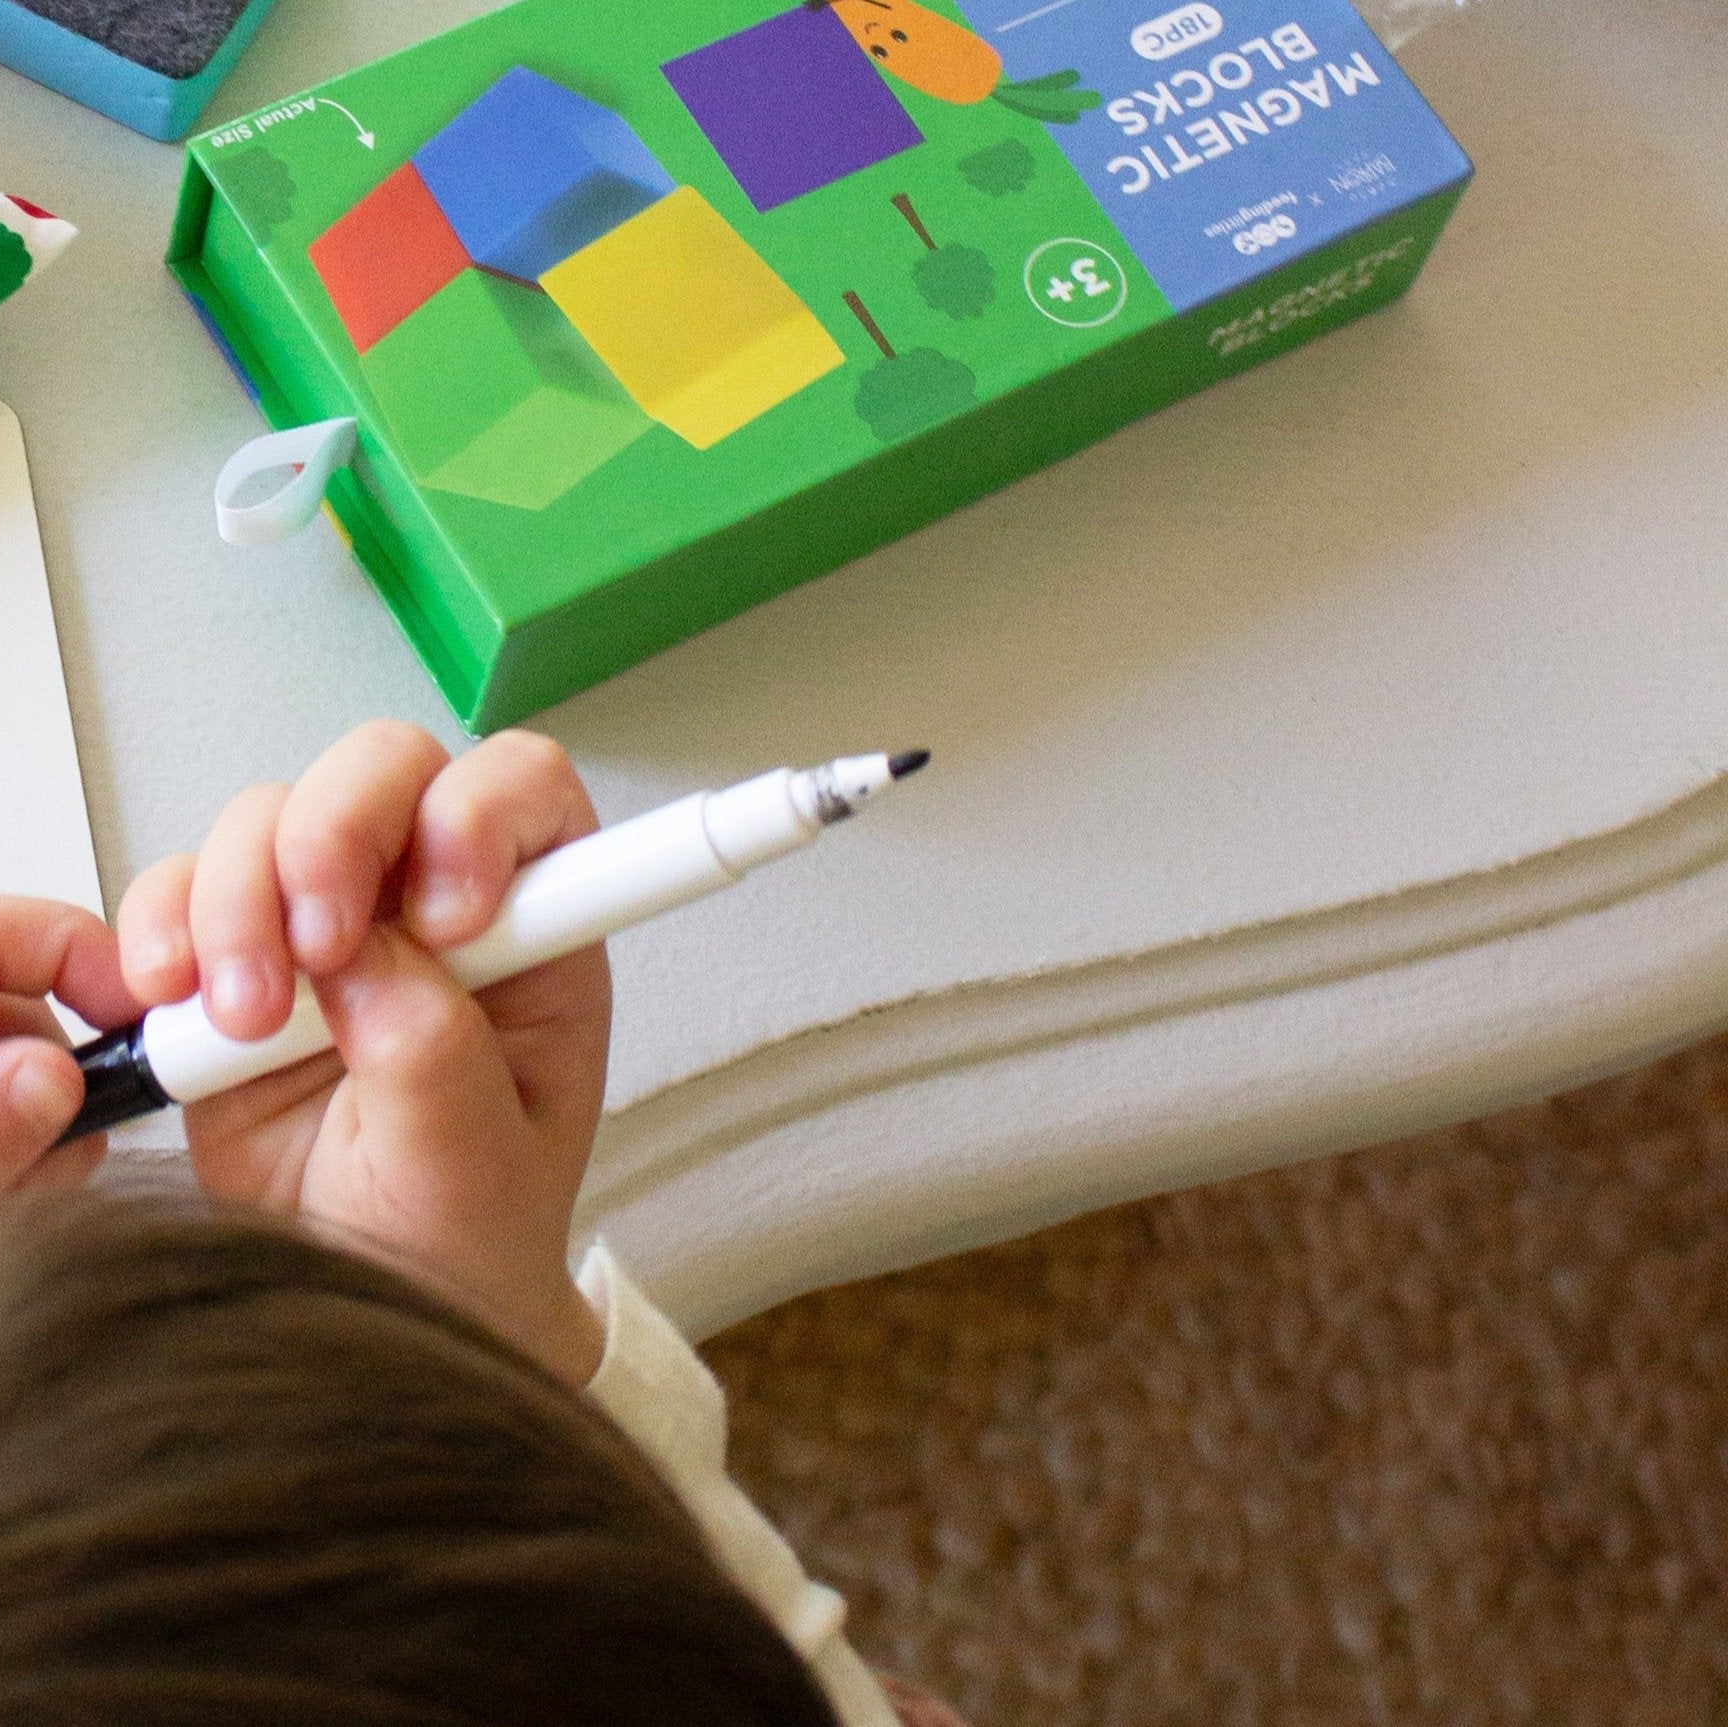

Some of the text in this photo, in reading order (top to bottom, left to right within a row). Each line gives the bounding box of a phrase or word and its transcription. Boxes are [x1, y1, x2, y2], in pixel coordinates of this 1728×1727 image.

[1141, 11, 1212, 52] 18PC
[1106, 22, 1319, 136] BLOCKS
[210, 96, 317, 148] Actual Size
[1106, 51, 1380, 194] MAGNETIC
[1046, 257, 1111, 303] 3+
